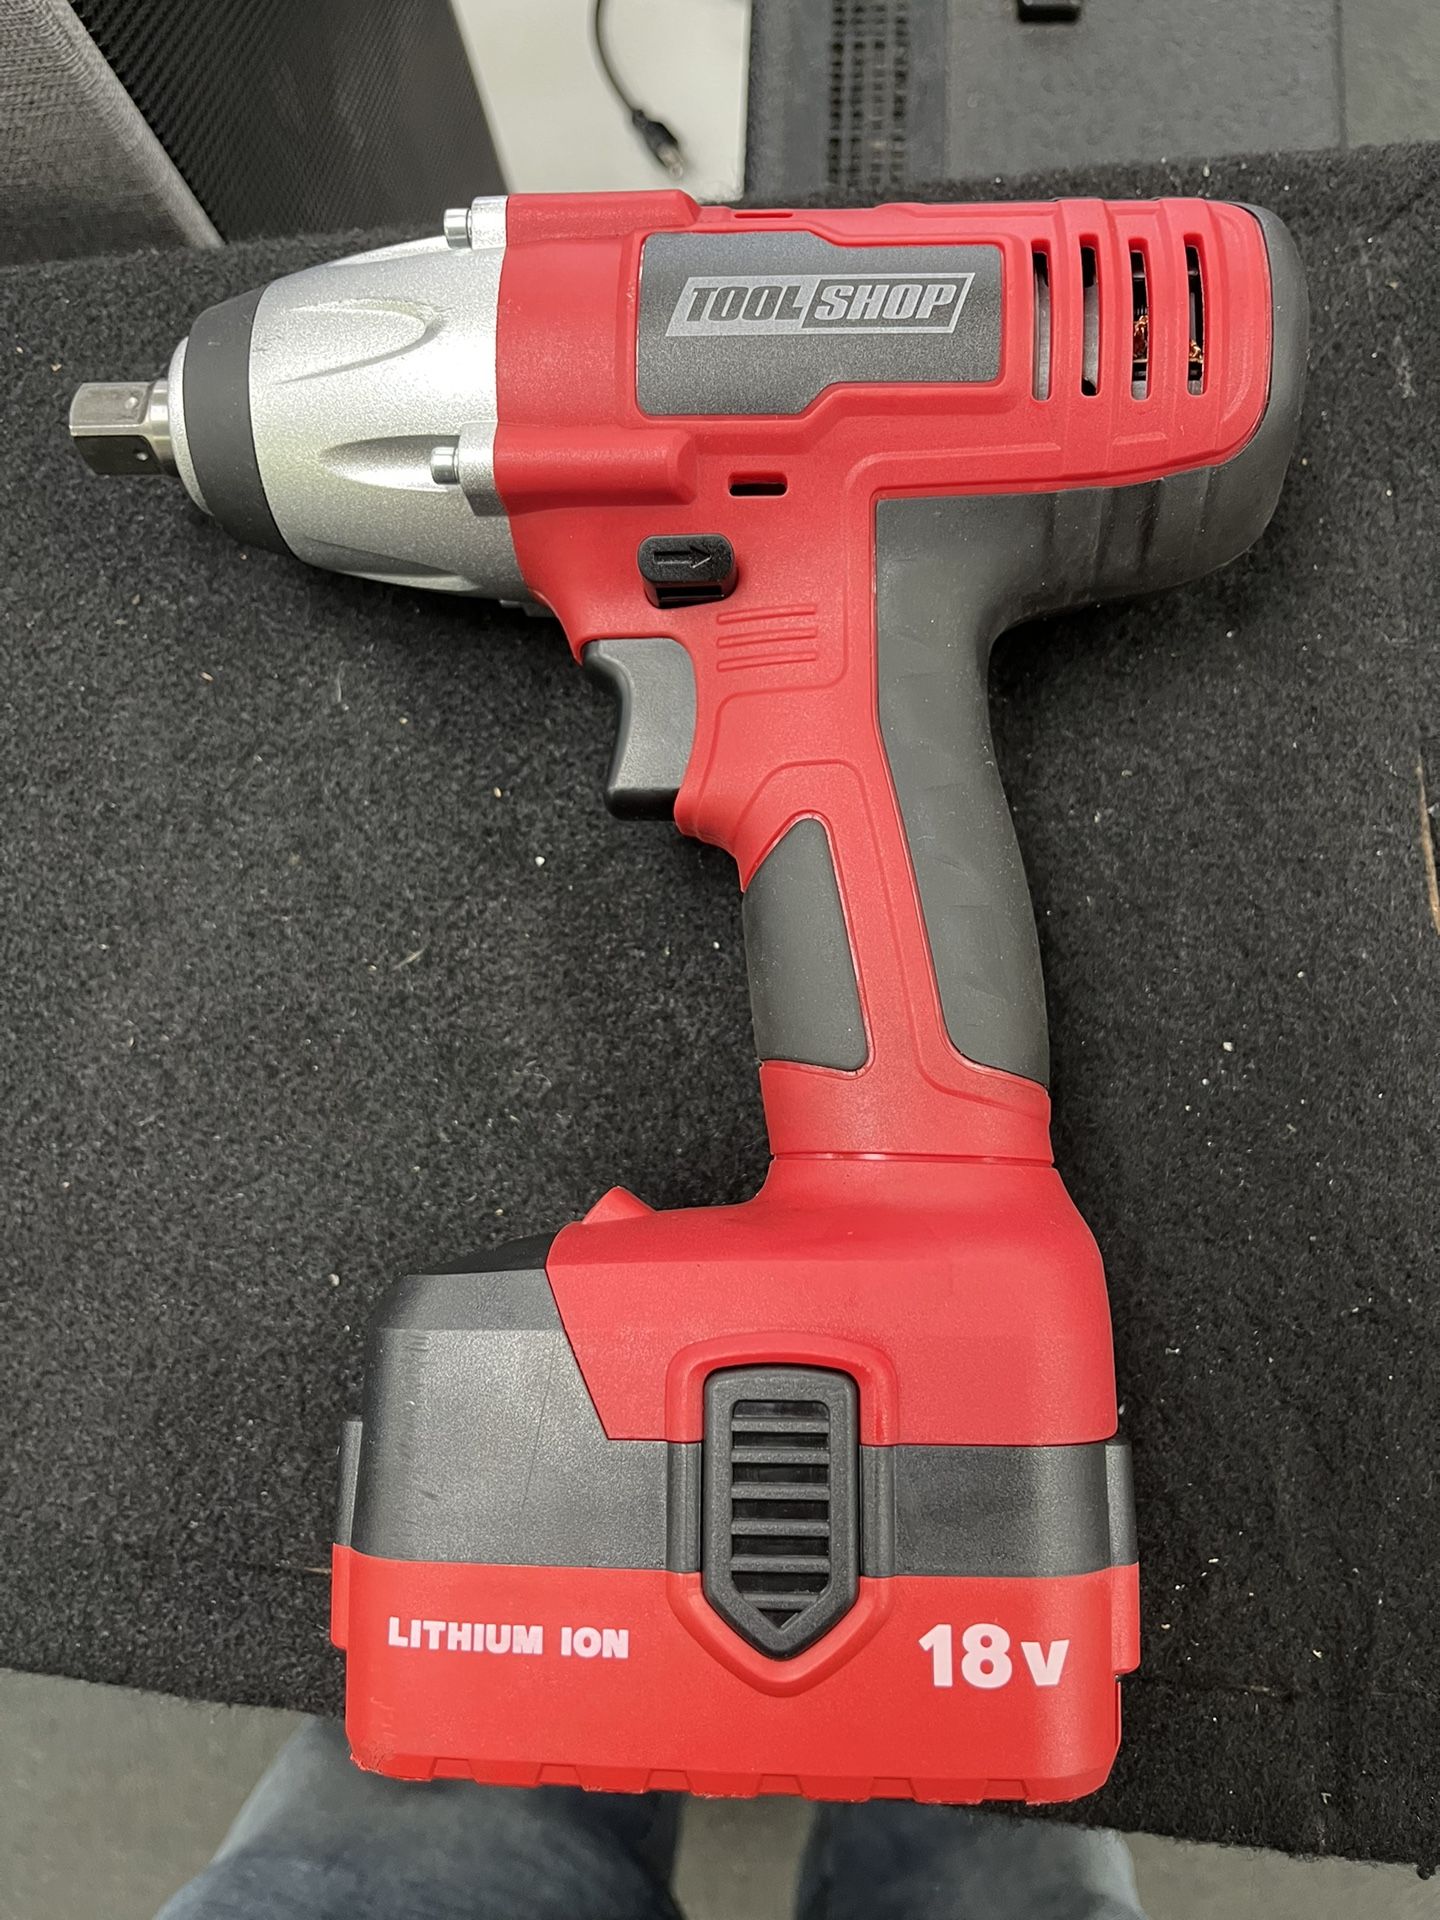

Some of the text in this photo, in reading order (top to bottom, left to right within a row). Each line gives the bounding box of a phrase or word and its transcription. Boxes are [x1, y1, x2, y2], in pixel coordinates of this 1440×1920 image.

[686, 284, 957, 322] TOOL SHOP
[387, 1616, 630, 1660] LITHIUM ION
